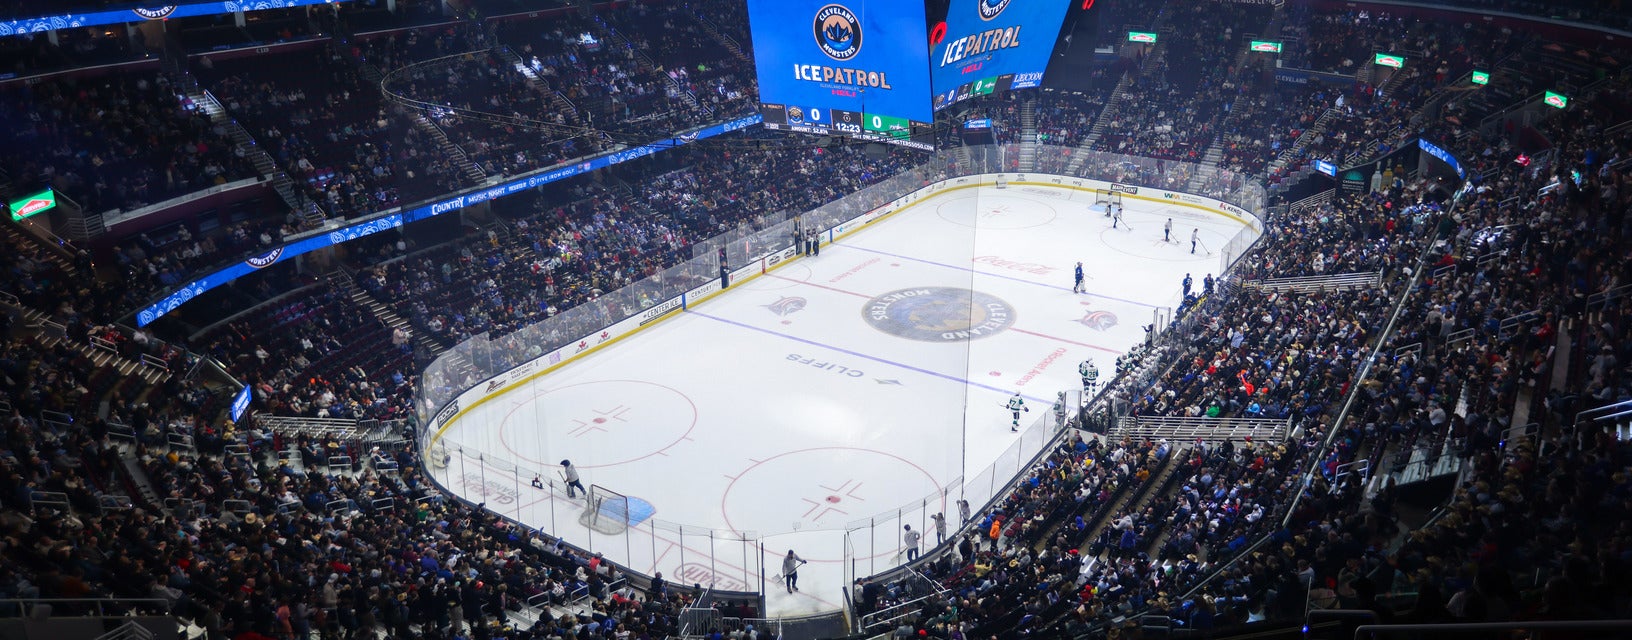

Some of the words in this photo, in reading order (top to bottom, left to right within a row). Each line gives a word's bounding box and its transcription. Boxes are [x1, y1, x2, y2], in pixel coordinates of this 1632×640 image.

[819, 7, 855, 24] CLEVELAND
[823, 43, 856, 58] MONSTERS
[975, 80, 983, 91] 0
[811, 108, 820, 121] 0
[872, 115, 882, 129] 0
[835, 122, 861, 133] 12:23
[431, 196, 465, 216] COUNTRY
[647, 303, 670, 318] CENTER
[670, 298, 679, 307] ICE
[872, 289, 931, 321] MONSTERS
[941, 302, 1007, 340] CLEVELAND
[785, 353, 865, 378] CLIFFS
